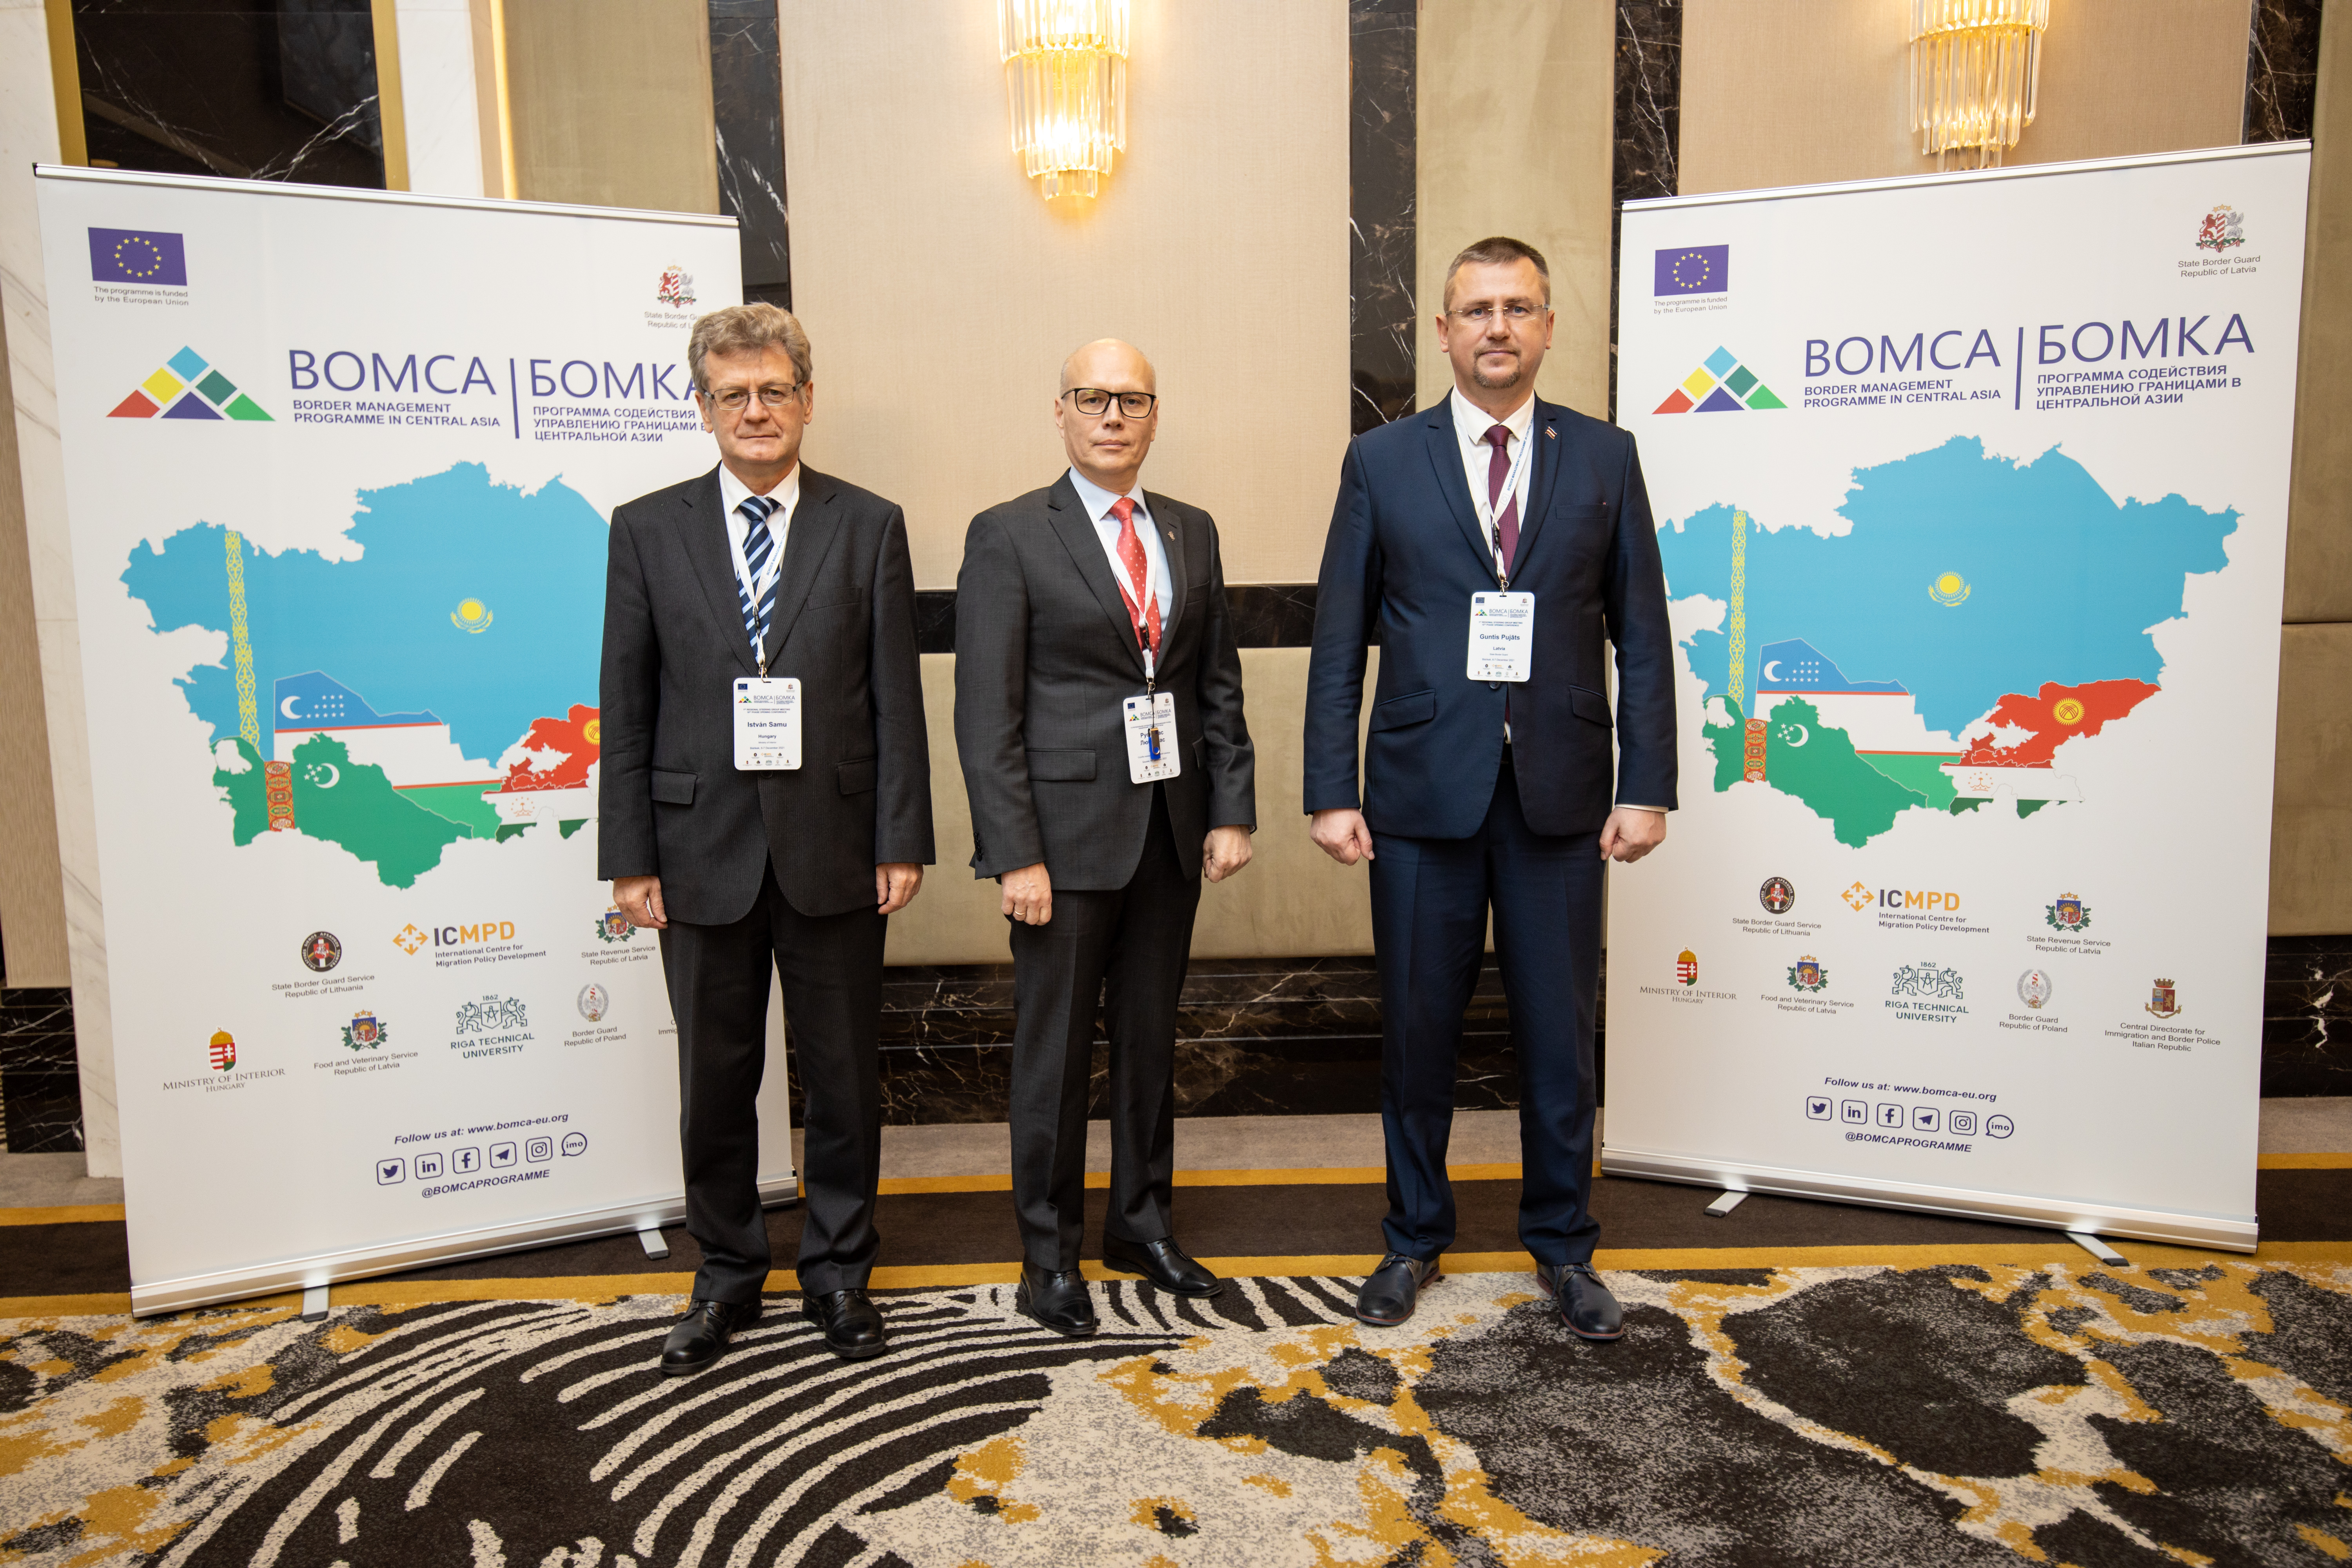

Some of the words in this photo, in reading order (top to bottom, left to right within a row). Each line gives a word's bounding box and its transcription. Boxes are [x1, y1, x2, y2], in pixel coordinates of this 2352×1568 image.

[2202, 258, 2232, 266] Border
[2234, 255, 2261, 264] Guard
[2181, 269, 2218, 278] Republic
[2230, 266, 2257, 274] Latvia
[2038, 313, 2255, 365] БОМКА
[1805, 328, 2001, 377] BOMCA
[289, 349, 497, 396] BOMCA
[2038, 370, 2124, 384] ПРОГРАММА
[2128, 365, 2227, 380] СОДЕЙСТВИЯ
[1804, 384, 1857, 396] BORDER
[1861, 379, 1953, 393] MANAGEMENT
[2036, 383, 2134, 397] УПРАВЛЕНИЮ
[2138, 378, 2227, 392] ГРАНИЦАМИ
[2232, 377, 2241, 388] В
[1804, 395, 1886, 408] PROGRAMME
[1890, 394, 1902, 404] IN
[1906, 391, 1967, 403] CENTRAL
[1970, 389, 2001, 400] ASIA
[2036, 395, 2140, 411] ЦЕНТРАЛЬНОЙ
[2144, 393, 2183, 405] АЗИИ
[293, 399, 352, 411] BORDER
[356, 401, 451, 413] MANAGEMENT
[533, 406, 611, 417] ПРОГРАММА
[614, 407, 695, 419] СОДЕЙСТВИЯ
[294, 412, 385, 425] PROGRAMME
[388, 415, 401, 425] IN
[405, 415, 468, 426] CENTRAL
[470, 417, 501, 427] ASIA
[533, 418, 621, 430] УПРАВЛЕНИЮ
[624, 420, 697, 432] ГРАНИЦАМИ
[535, 430, 627, 442] ЦЕНТРАЛЬНОЙ
[630, 432, 663, 442] АЗИИ
[1512, 459, 1520, 479] MANAGEMENT
[772, 540, 783, 562] MANAGEMENT
[1879, 889, 1960, 911] ICMPD
[1879, 912, 1927, 921] International
[1878, 920, 1914, 929] Migration
[1915, 923, 1938, 932] Policy
[1940, 924, 1990, 933] Development
[433, 921, 515, 947] ICMPD
[2048, 936, 2081, 945] Revenue
[435, 947, 484, 958] International
[2035, 944, 2068, 953] Republic
[436, 958, 472, 968] Migration
[498, 950, 546, 961] Development
[321, 977, 345, 985] Guard
[285, 989, 318, 998] Republic
[329, 984, 363, 993] Lithuania
[1778, 1004, 1806, 1012] Republic
[1793, 997, 1828, 1007] Veterinary
[1829, 1000, 1854, 1008] Service
[1885, 1000, 1909, 1009] RIGA
[1912, 1002, 1969, 1014] TECHNICAL
[1896, 1011, 1957, 1023] UNIVERSITY
[1999, 1021, 2031, 1030] Republic
[2042, 1025, 2068, 1033] Poland
[2120, 1022, 2148, 1031] Central
[2150, 1025, 2193, 1034] Directorate
[450, 1040, 475, 1049] RIGA
[478, 1033, 535, 1046] TECHNICAL
[2105, 1030, 2149, 1040] Immigration
[2168, 1035, 2195, 1043] Border
[2196, 1037, 2221, 1045] Police
[462, 1044, 524, 1059] UNIVERSITY
[2132, 1040, 2155, 1049] Italian
[2158, 1043, 2192, 1052] Republic
[1824, 1077, 1859, 1088] Follow
[1894, 1085, 1997, 1103] www.bomca-eu.org
[394, 1133, 431, 1145] Follow
[434, 1131, 447, 1139] us
[450, 1127, 464, 1137] at:
[467, 1114, 569, 1134] www.bomca-eu.org
[1991, 1123, 2009, 1131] imo
[1845, 1132, 1973, 1152] @BOMCAPROGRAMME
[421, 1169, 550, 1198] @BOMCAPROGRAMME
